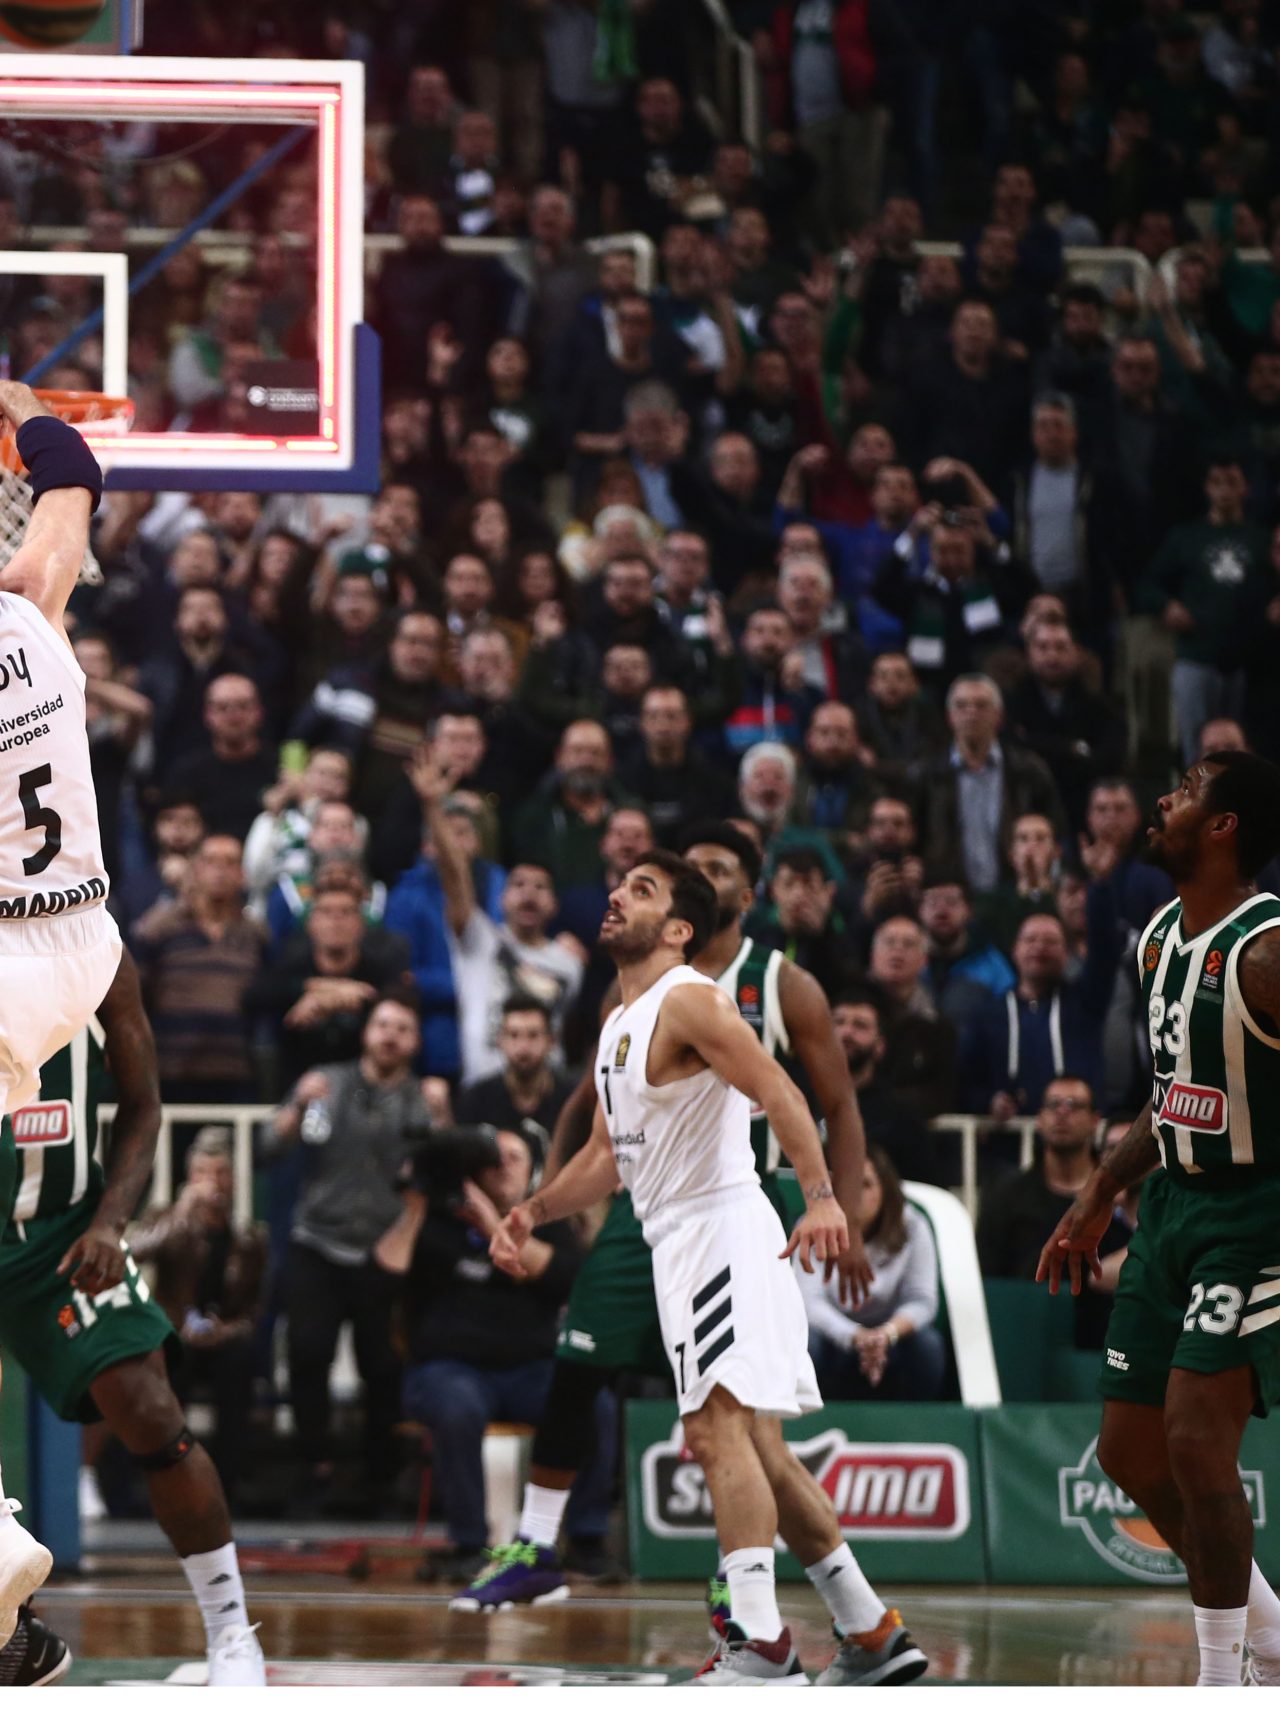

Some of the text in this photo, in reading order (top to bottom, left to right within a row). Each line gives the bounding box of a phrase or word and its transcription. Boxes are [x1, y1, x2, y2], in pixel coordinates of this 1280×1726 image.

[18, 763, 62, 876] 5
[1149, 993, 1187, 1056] 23
[1183, 1282, 1245, 1336] 23
[1107, 1348, 1126, 1361] TOYO
[1107, 1357, 1130, 1371] TIRES
